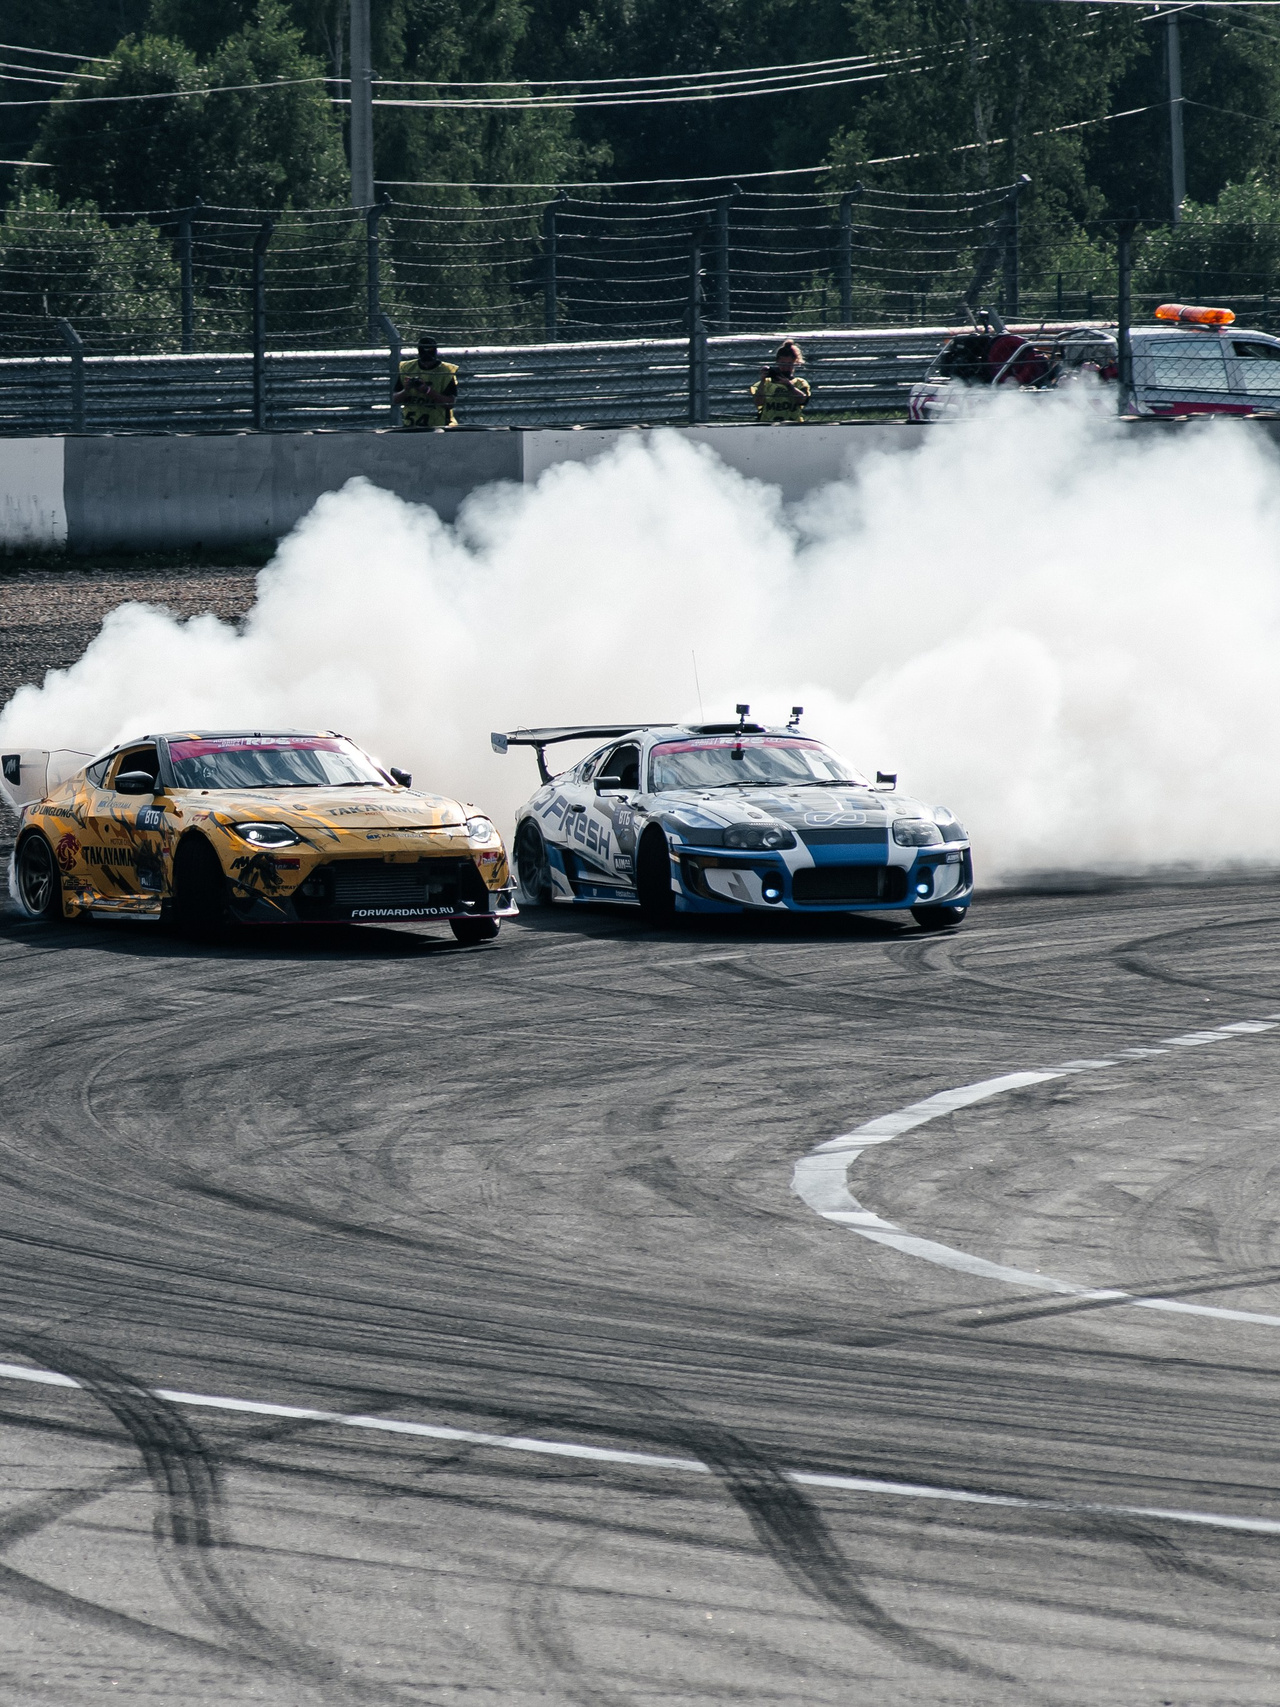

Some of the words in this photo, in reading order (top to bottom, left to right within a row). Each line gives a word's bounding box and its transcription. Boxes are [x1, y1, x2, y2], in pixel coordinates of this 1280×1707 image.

[39, 806, 74, 818] LINGLONG
[326, 804, 423, 816] TAKAYAMA
[82, 846, 134, 867] TAKAYAMA
[351, 907, 454, 918] FORWARDAUTO.RU
